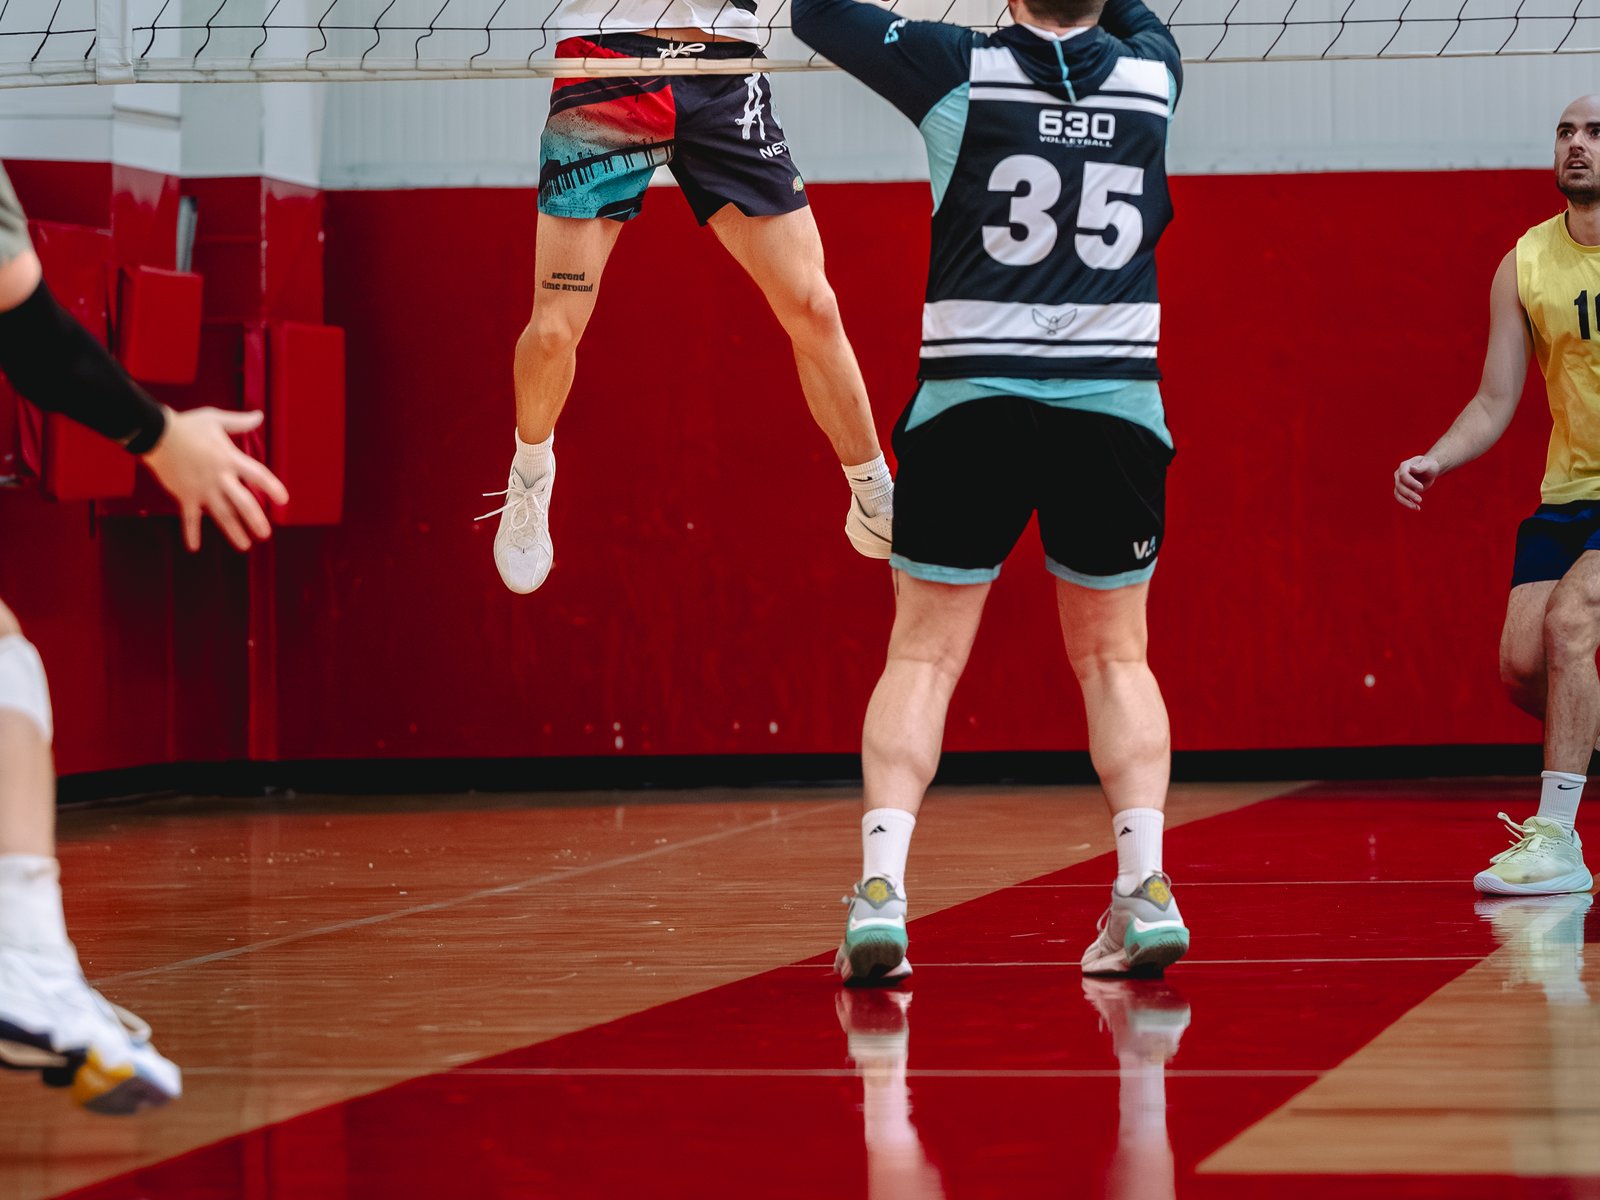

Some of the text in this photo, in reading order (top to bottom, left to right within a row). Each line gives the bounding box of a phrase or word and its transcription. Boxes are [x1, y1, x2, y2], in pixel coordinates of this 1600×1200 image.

[1038, 108, 1116, 140] 630
[1039, 135, 1113, 148] VOLLEYBALL
[982, 154, 1145, 270] 35
[541, 280, 594, 292] time around
[551, 271, 586, 281] second
[1573, 289, 1600, 341] 1
